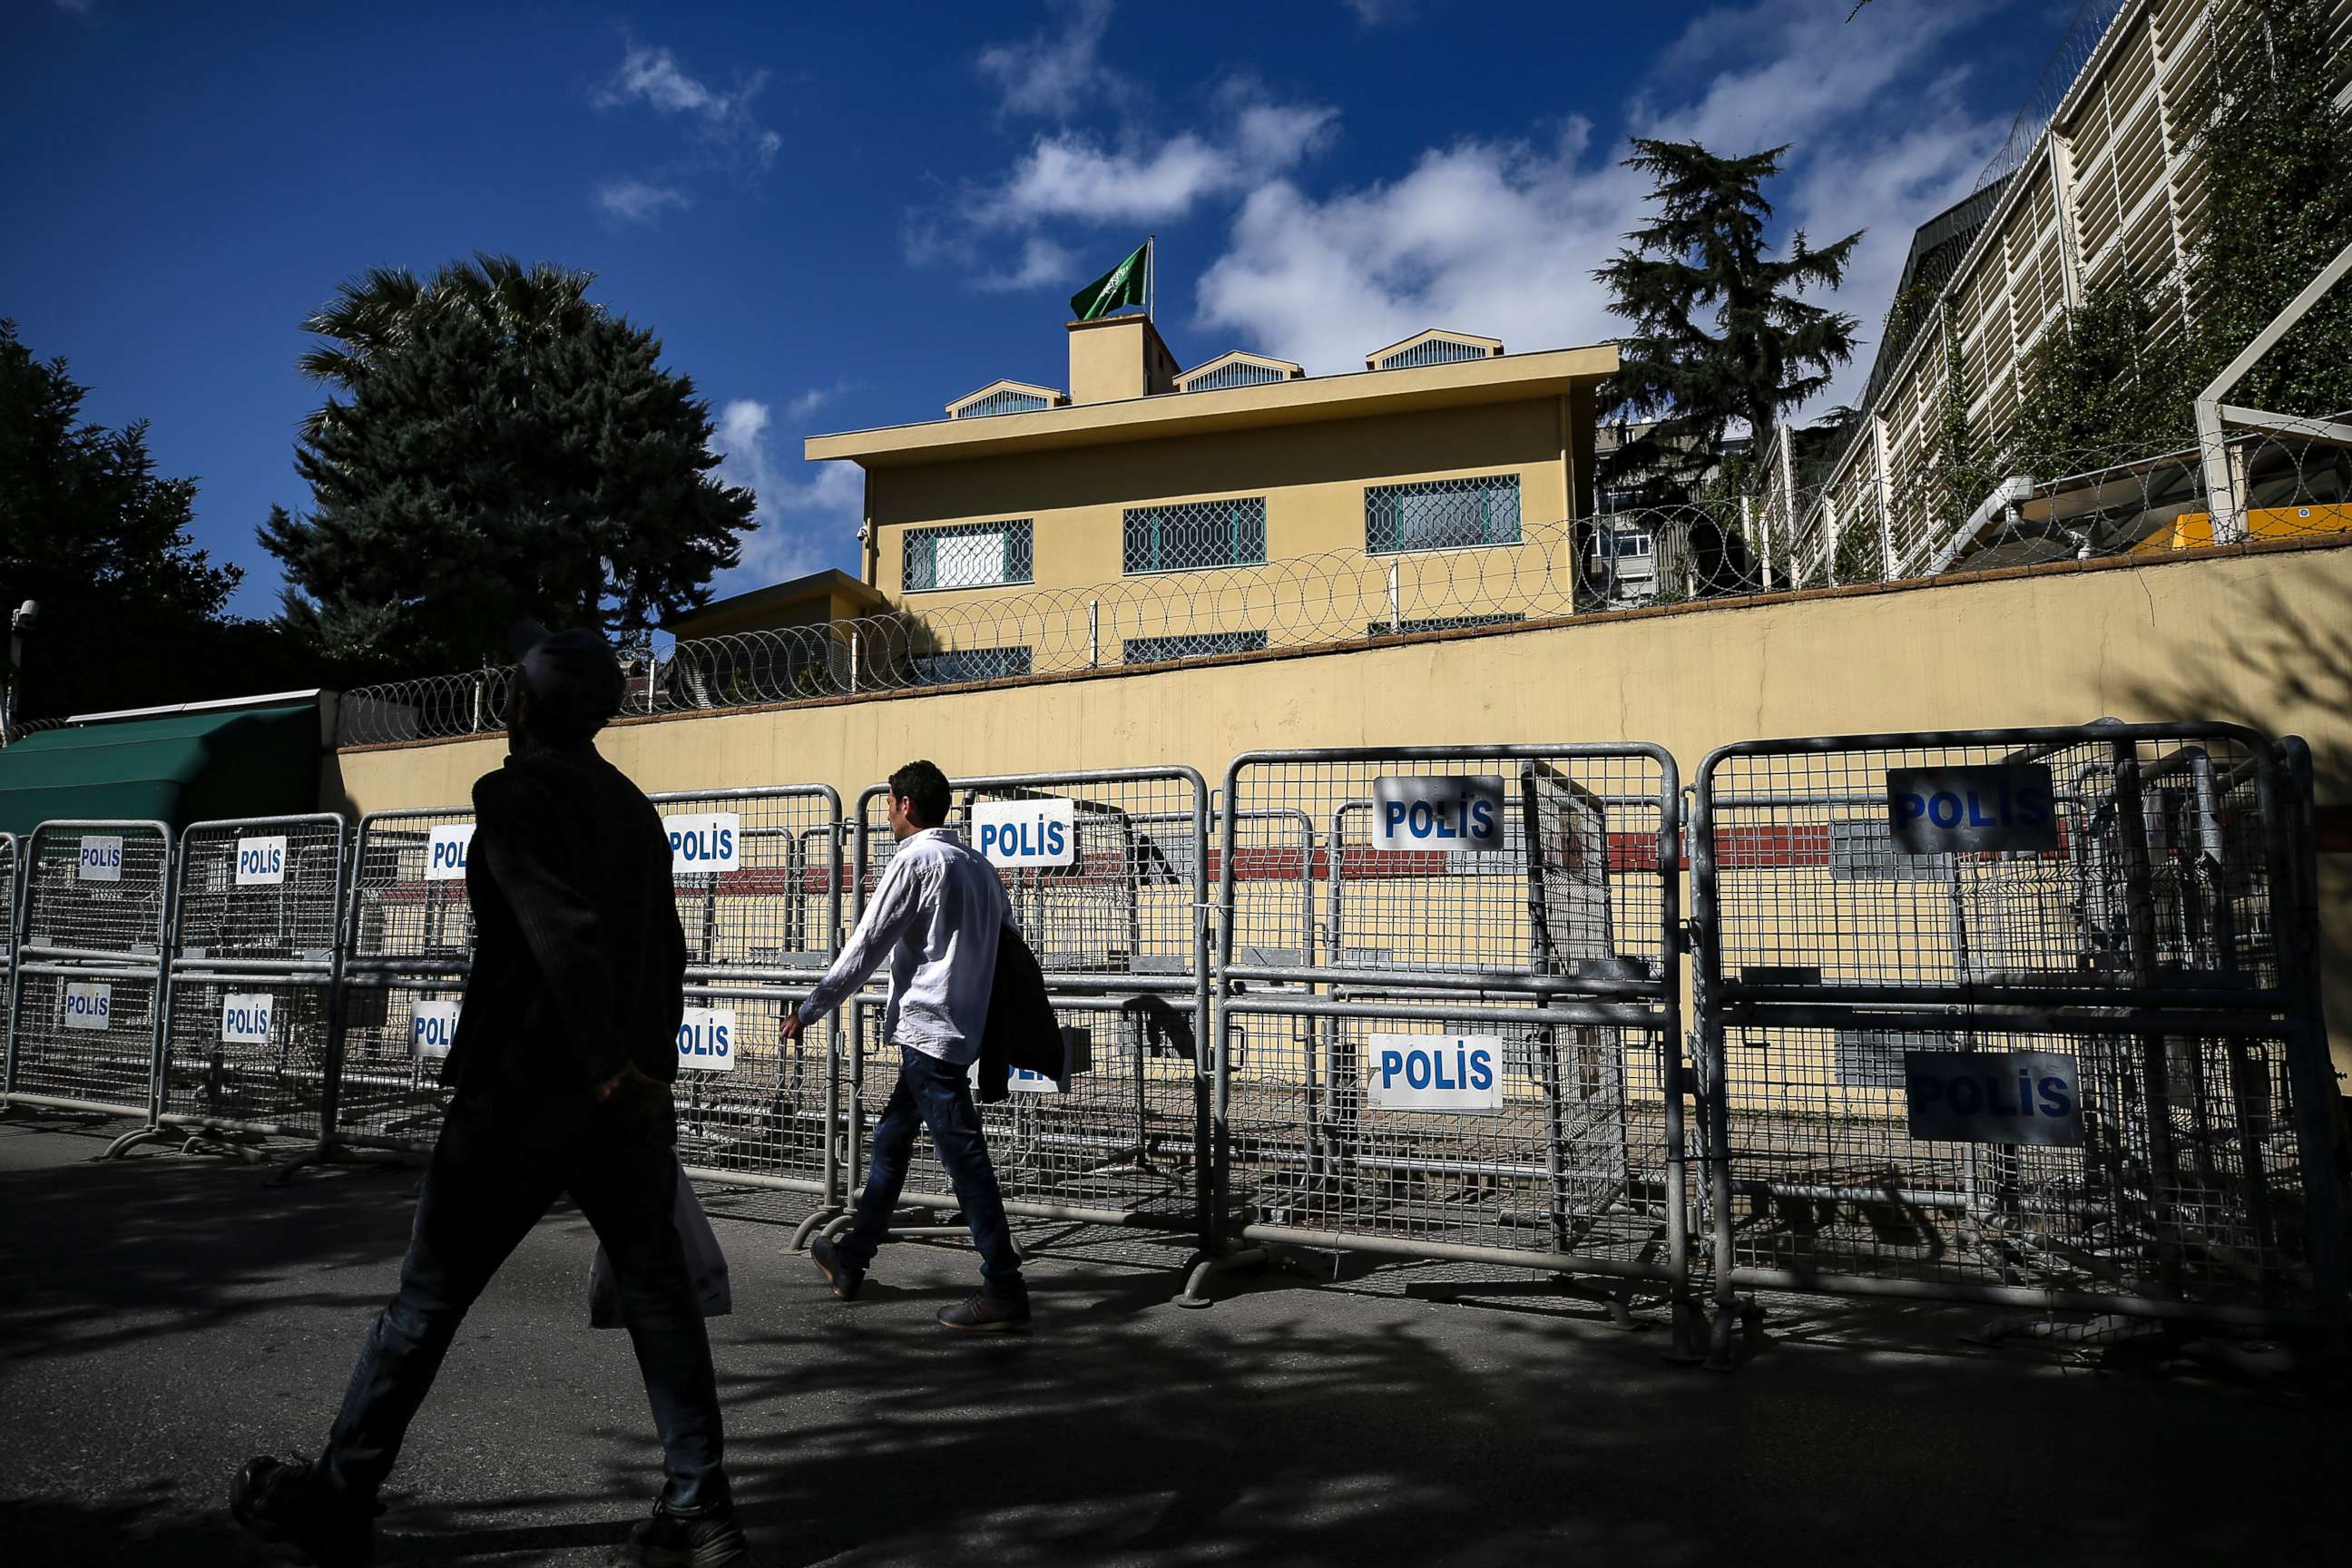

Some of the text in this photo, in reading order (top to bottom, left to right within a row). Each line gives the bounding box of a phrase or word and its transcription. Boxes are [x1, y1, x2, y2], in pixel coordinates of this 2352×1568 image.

[1386, 792, 1494, 839] POLİS
[1895, 782, 2051, 829] POLİS
[433, 841, 466, 868] POL
[670, 822, 732, 861] POLİS
[981, 813, 1064, 858] POLİS
[82, 844, 120, 867] POLİS
[240, 844, 279, 874] POLİS
[67, 993, 108, 1016] POLİS
[227, 1004, 266, 1034] POLİS
[415, 1011, 456, 1046] POLİ
[679, 1017, 729, 1057] OLİS
[1382, 1041, 1494, 1090] POLİS
[1911, 1068, 2072, 1118] POLİS
